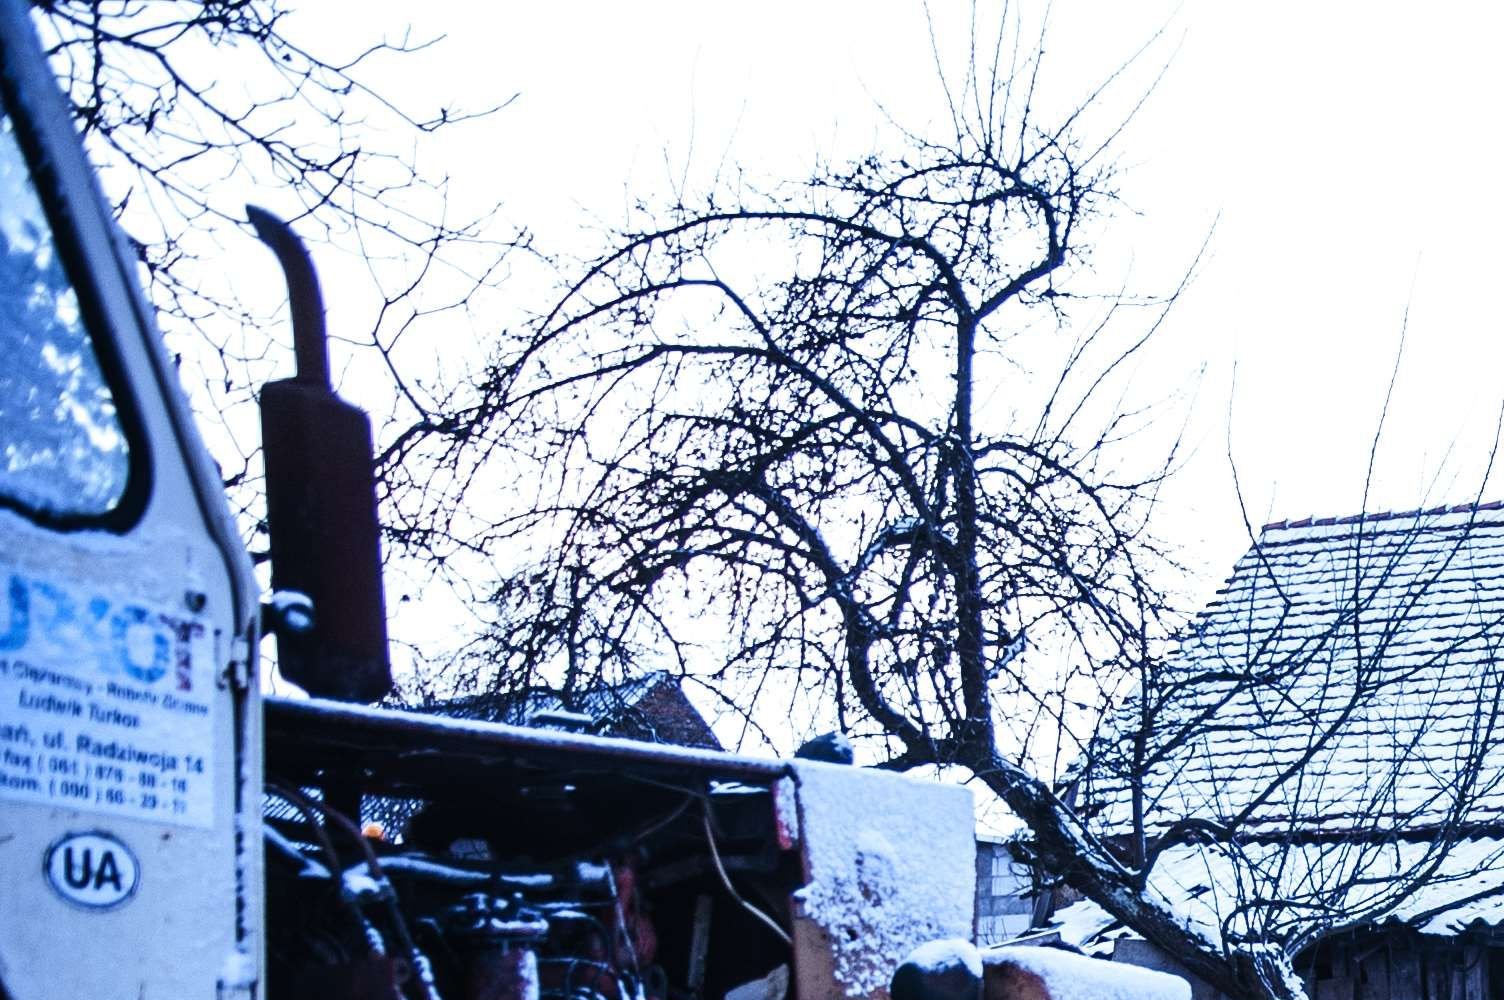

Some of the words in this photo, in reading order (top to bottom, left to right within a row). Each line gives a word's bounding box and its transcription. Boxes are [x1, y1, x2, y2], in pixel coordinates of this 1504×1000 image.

[19, 688, 82, 717] Ludwik
[185, 754, 205, 774] 14
[63, 846, 122, 892] UA
